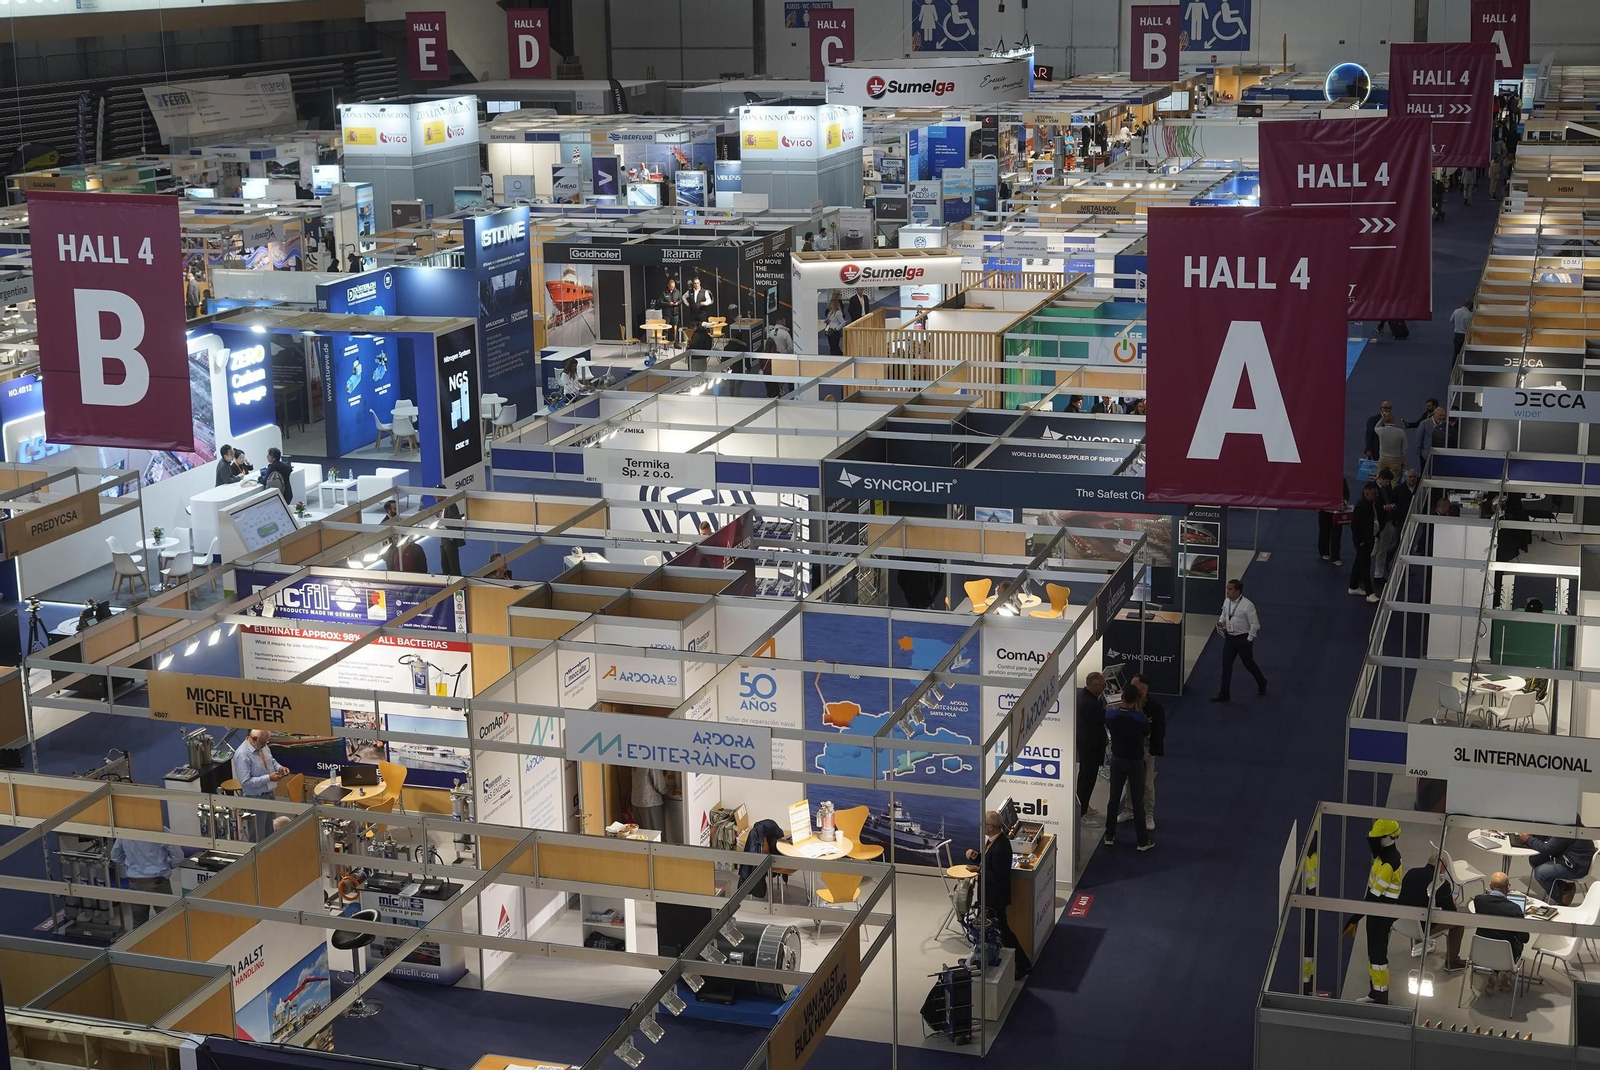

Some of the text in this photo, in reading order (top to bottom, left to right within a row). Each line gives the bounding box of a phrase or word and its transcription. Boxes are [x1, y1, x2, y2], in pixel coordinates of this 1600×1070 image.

[841, 21, 846, 29] 4
[1140, 17, 1171, 26] HALL 4
[1482, 14, 1516, 23] HALL 4
[418, 38, 438, 71] E
[518, 35, 540, 68] D
[821, 36, 843, 66] C
[1143, 33, 1166, 69] B
[1490, 30, 1512, 67] A
[888, 80, 955, 96] Sumelga
[1412, 70, 1470, 85] HALL 4
[1407, 104, 1443, 114] HALL 1
[1297, 162, 1389, 188] HALL 4
[481, 221, 525, 247] STOWE
[58, 234, 154, 265] HALL 4
[572, 250, 619, 259] Goldhofer
[862, 266, 924, 280] Sumelga
[1184, 256, 1310, 290] HALL 4
[74, 288, 150, 406] B
[443, 349, 471, 363] Nitrogen System
[1505, 358, 1543, 368] DECCA
[8, 384, 32, 397] NO.4B12
[449, 370, 468, 392] NGS
[1187, 320, 1301, 464] A
[1515, 392, 1586, 409] DECCA
[1514, 409, 1541, 418] wiper
[622, 467, 640, 478] Sp.
[653, 470, 674, 479] o.o.
[625, 458, 670, 469] Termika
[455, 474, 474, 489] SMDERI
[1076, 488, 1094, 498] The
[1097, 489, 1128, 500] Safest
[31, 510, 78, 536] PREDYCSA
[254, 625, 448, 649] ELIMINATE APPROX: 98% ALL BACTERIAS
[997, 648, 1045, 664] ComAp
[620, 672, 665, 686] ARDORA
[738, 671, 778, 699] 50
[187, 687, 292, 710] MICFIL ULTRA
[740, 698, 777, 712] AÑOS
[196, 702, 284, 723] FINE FILTER
[479, 716, 503, 739] ComAp
[692, 731, 755, 749] ARDORA
[1454, 747, 1592, 772] 3L INTERNACIONAL
[1409, 768, 1428, 777] 4A09
[484, 792, 492, 803] GAS
[493, 778, 511, 798] ENGINES
[237, 944, 264, 974] AALST
[235, 959, 264, 986] HANDLING
[803, 968, 839, 1024] VAN AALST
[794, 974, 847, 1061] BULK HANDLING
